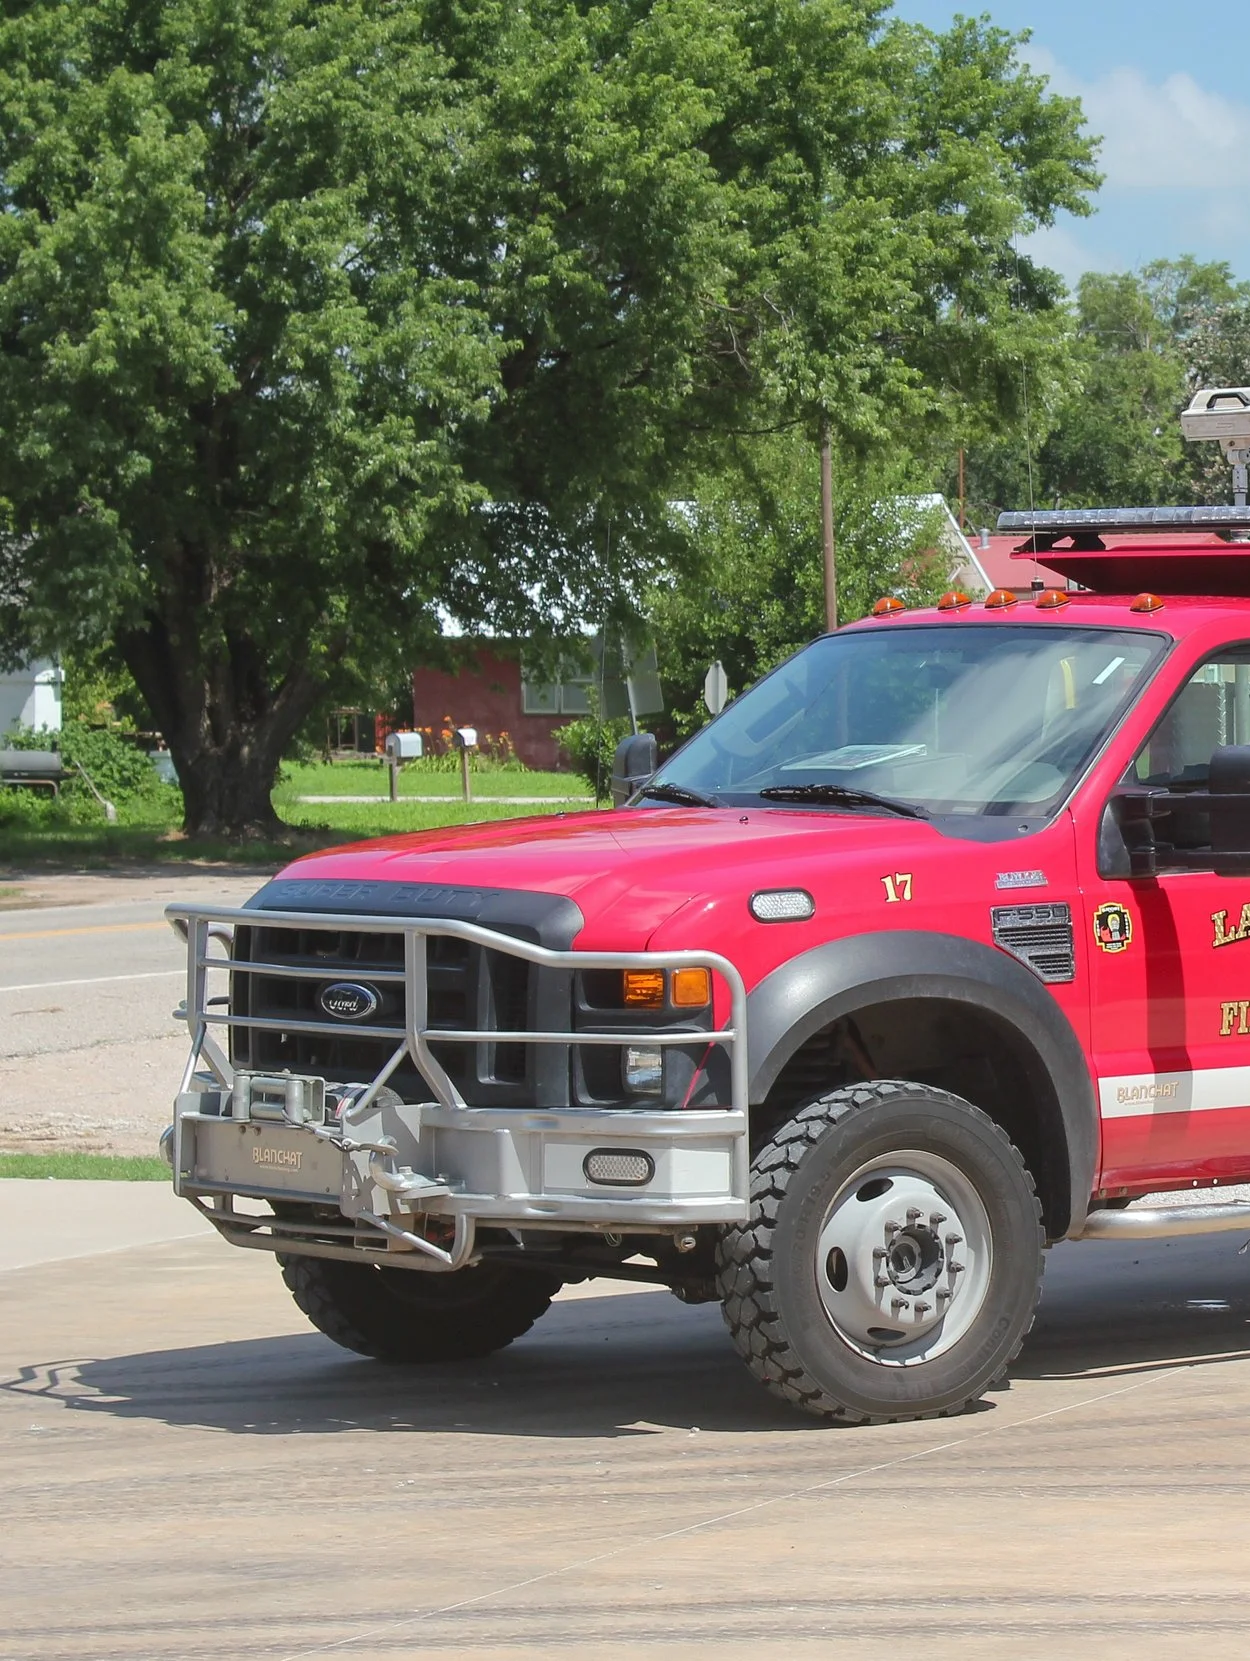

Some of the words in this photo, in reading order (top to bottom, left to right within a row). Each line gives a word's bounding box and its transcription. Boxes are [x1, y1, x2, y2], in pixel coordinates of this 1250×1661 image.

[275, 882, 378, 900] SUPER
[389, 886, 500, 908] DUTY
[880, 872, 912, 903] 17
[996, 904, 1067, 921] F-550
[1116, 1081, 1179, 1104] BLANCHAT
[252, 1147, 303, 1169] BLANCHAT
